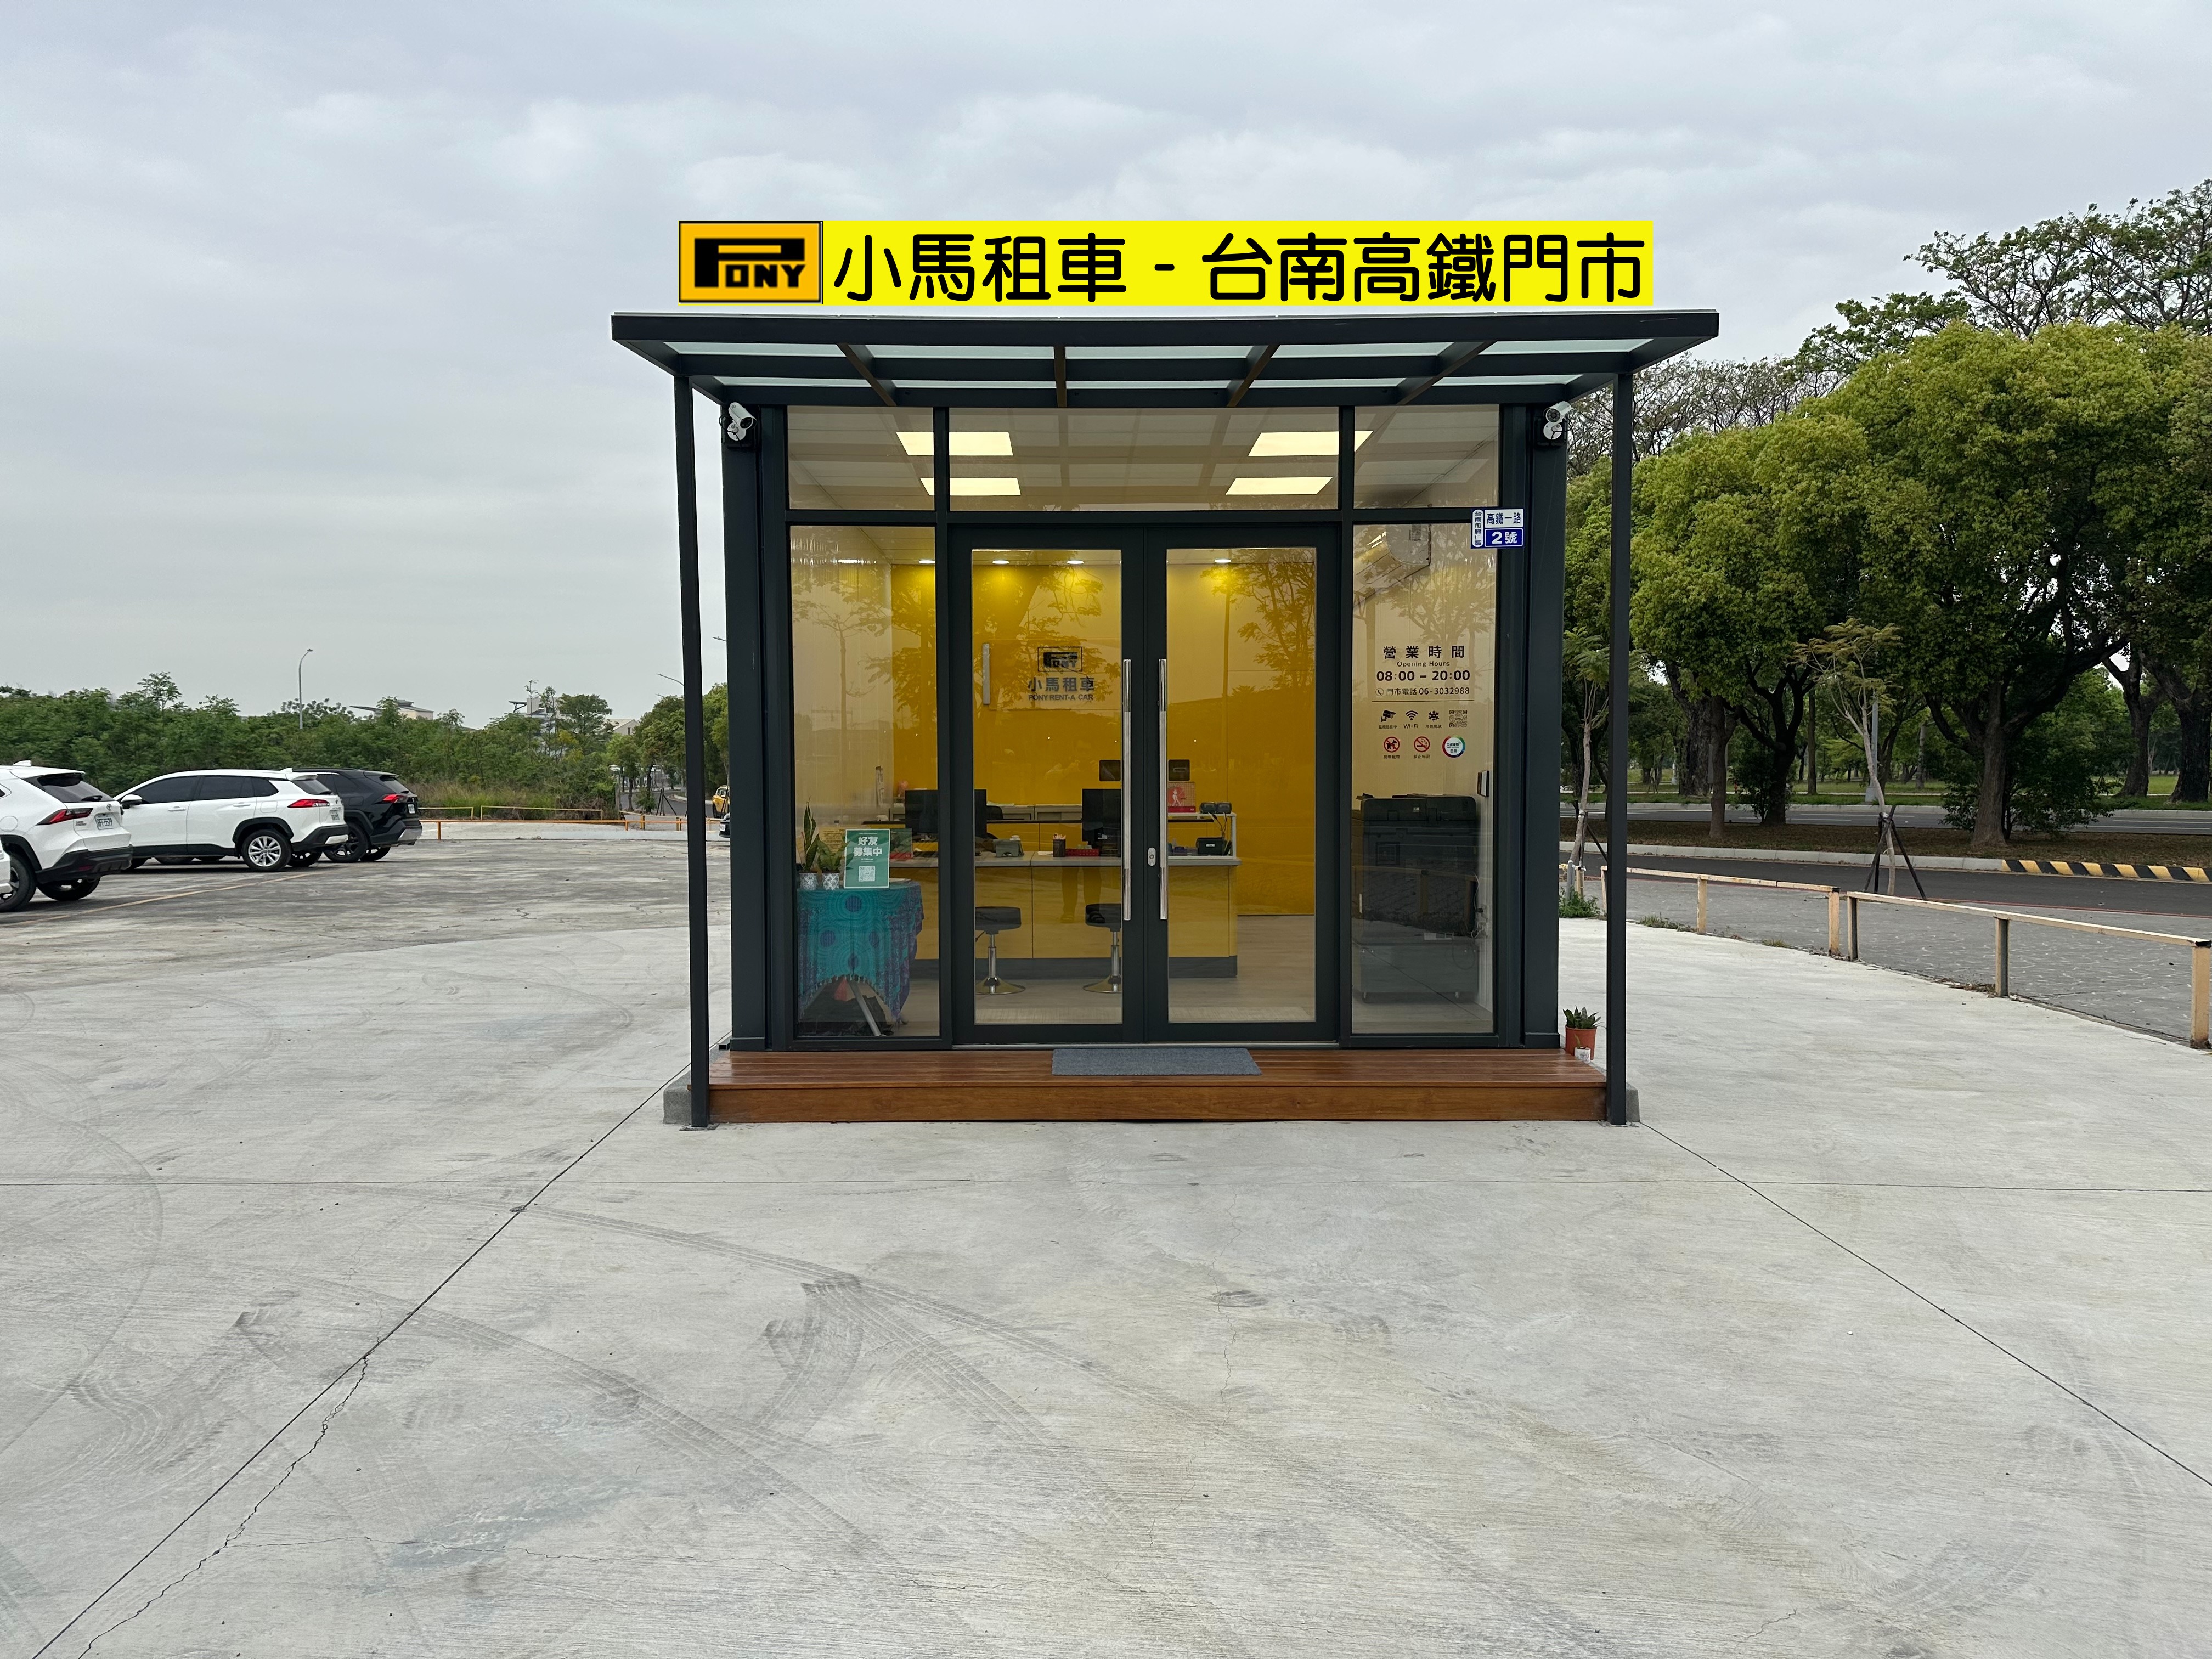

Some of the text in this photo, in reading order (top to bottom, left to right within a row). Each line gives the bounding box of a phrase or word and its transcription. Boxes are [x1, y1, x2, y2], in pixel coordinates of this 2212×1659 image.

[694, 238, 806, 288] PONY
[834, 232, 1127, 302] 小馬租車
[1201, 232, 1645, 302] 台南高鐵門市
[1487, 512, 1521, 524] 高鐵一路
[1492, 531, 1517, 544] 2號
[1383, 645, 1464, 659] 營業時間
[1376, 671, 1415, 681] 08:00
[1432, 670, 1470, 681] 20:00
[1028, 677, 1094, 692] 小馬租車
[858, 836, 878, 845] 好友
[853, 847, 882, 856] 募集中
